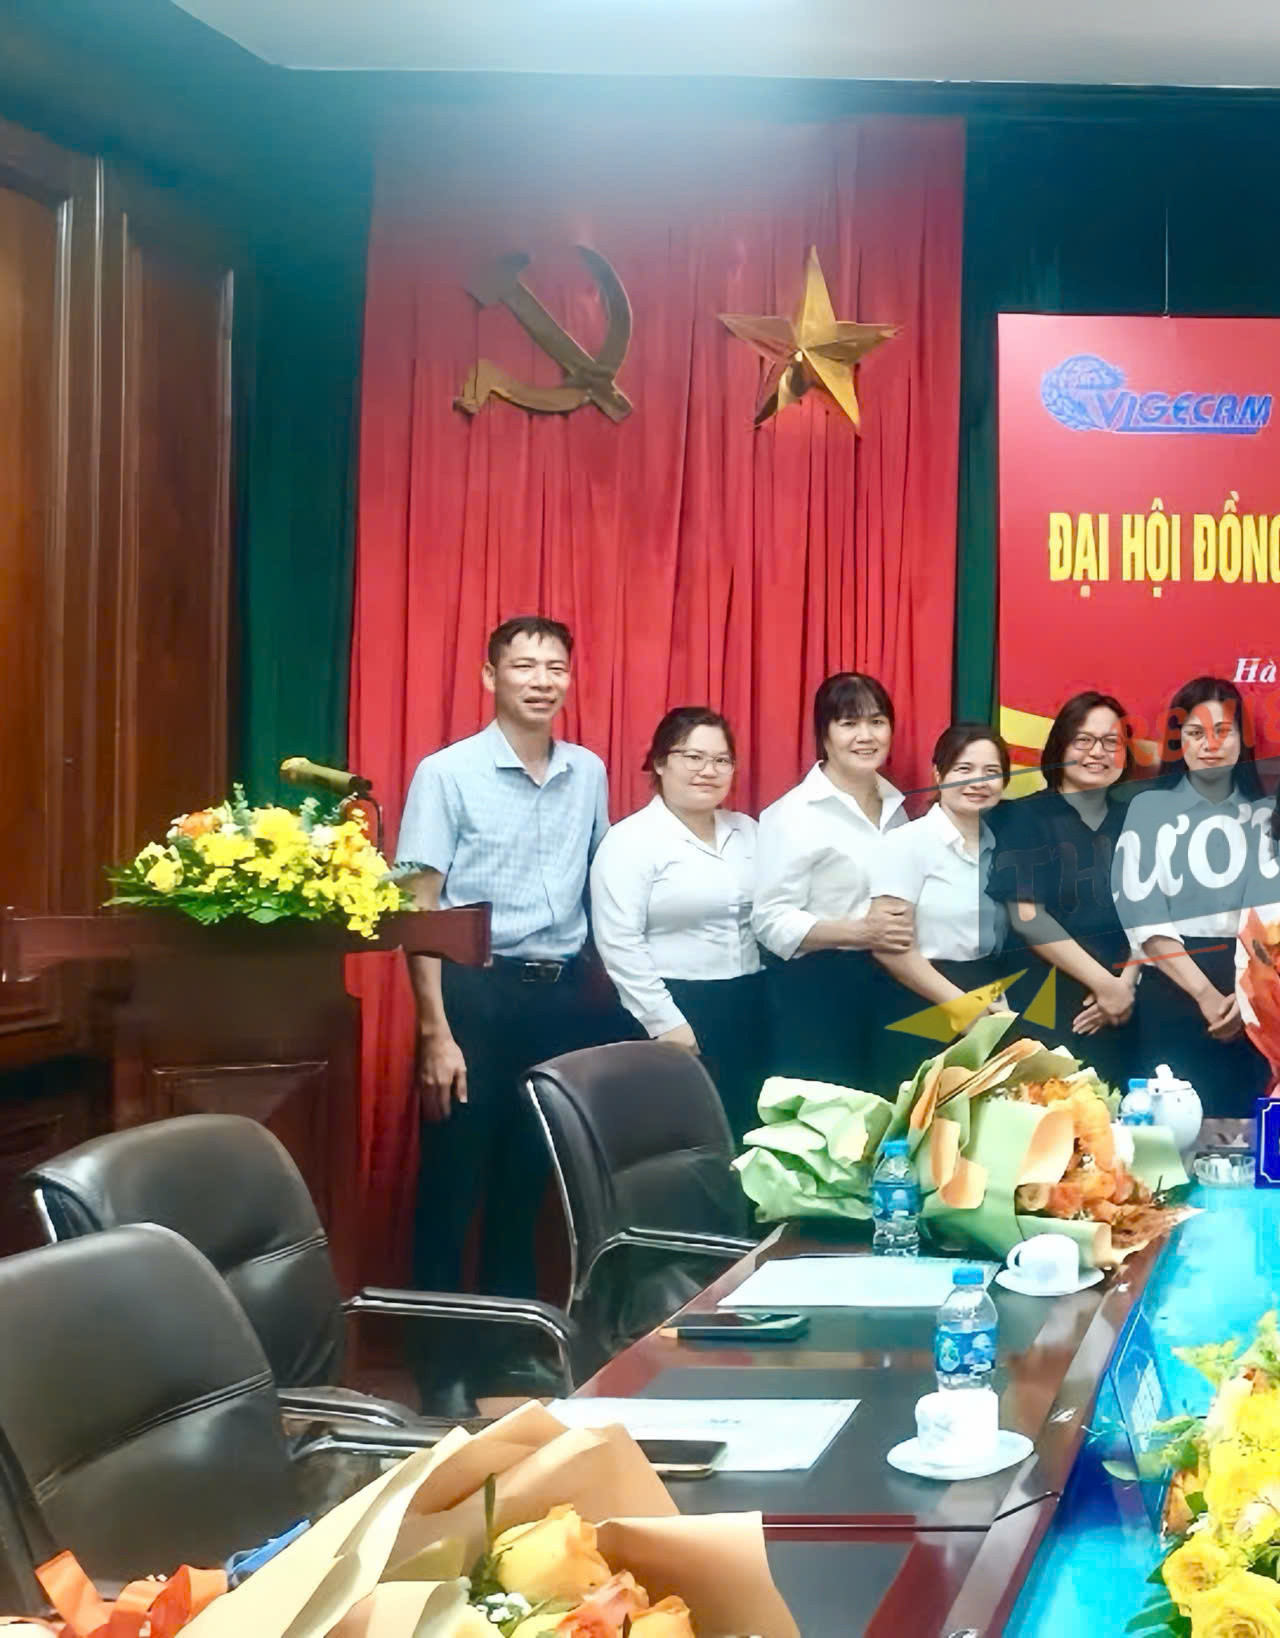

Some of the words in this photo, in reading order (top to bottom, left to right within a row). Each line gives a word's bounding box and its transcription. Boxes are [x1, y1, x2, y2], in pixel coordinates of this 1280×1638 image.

[1095, 391, 1272, 427] VIGECAM
[1048, 511, 1110, 598] ĐẠI
[1121, 497, 1181, 598] HỘI
[1233, 658, 1277, 683] Hà
